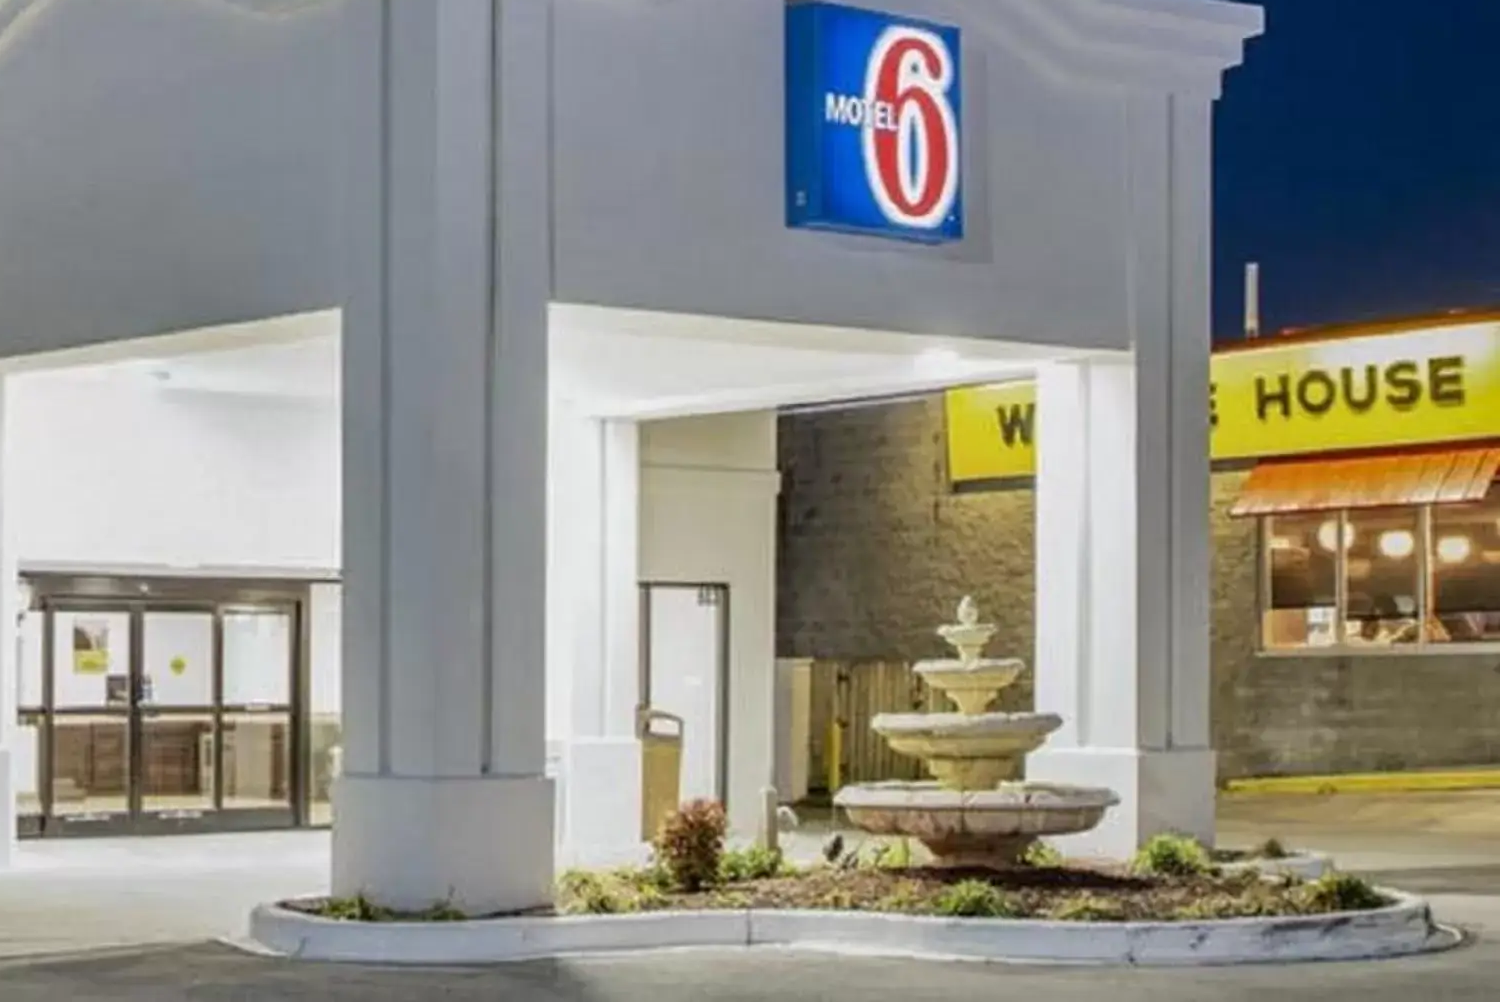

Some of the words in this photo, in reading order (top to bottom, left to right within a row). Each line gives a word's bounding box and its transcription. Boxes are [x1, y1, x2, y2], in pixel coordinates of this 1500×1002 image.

[825, 92, 900, 131] MOTEL
[863, 26, 958, 228] 6
[1255, 356, 1466, 421] HOUSE
